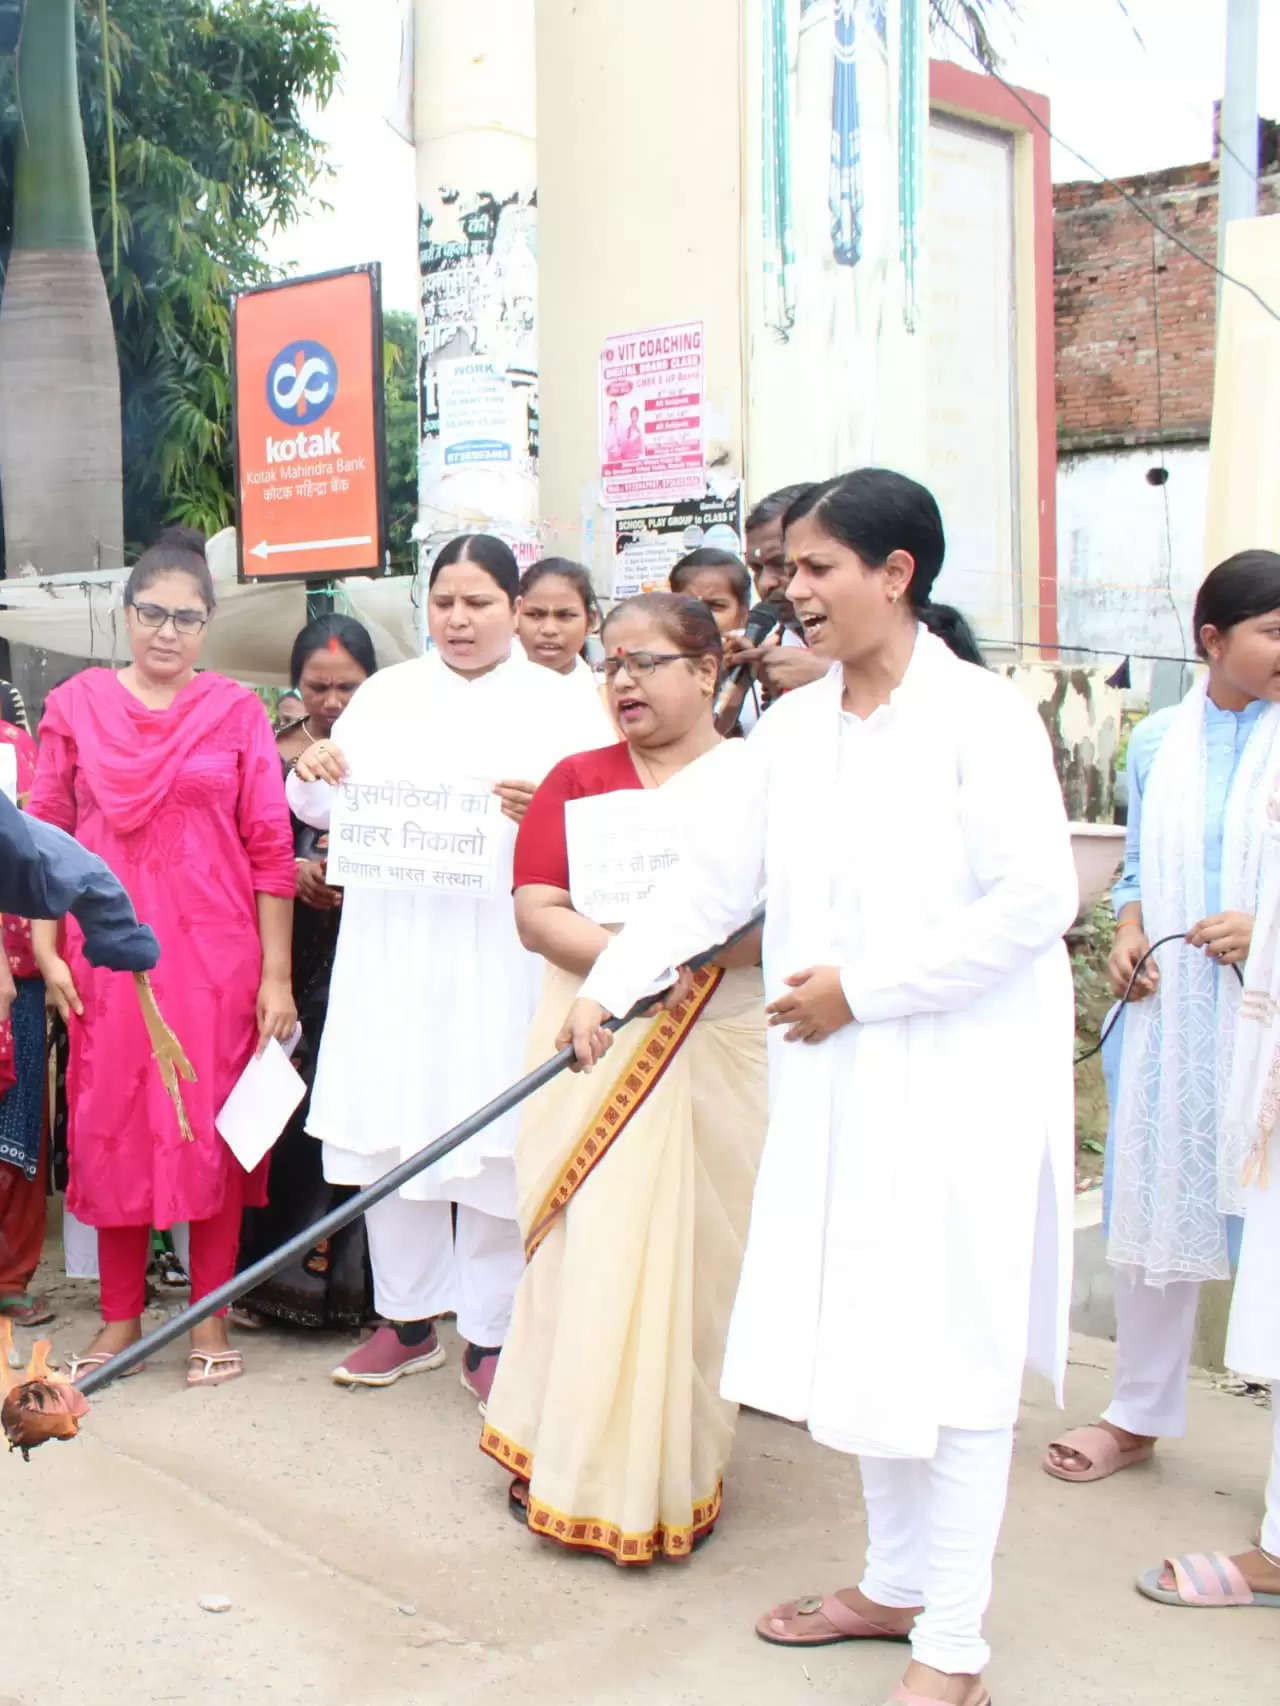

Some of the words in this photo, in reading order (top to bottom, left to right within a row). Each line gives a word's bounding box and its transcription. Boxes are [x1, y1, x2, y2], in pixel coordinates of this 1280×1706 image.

[618, 343, 636, 360] VIT
[640, 332, 700, 358] COACHING
[266, 427, 341, 464] kotak
[246, 468, 277, 484] Kotak
[280, 461, 333, 481] Mahindra
[336, 456, 366, 473] Bank
[263, 482, 292, 501] कोटक
[331, 477, 350, 494] बैंक
[618, 520, 646, 530] SCHOOL
[648, 518, 666, 528] PLAY
[668, 515, 693, 526] GROUP
[695, 514, 702, 524] to
[704, 512, 728, 523] CLASS
[339, 823, 393, 848] बाहर
[403, 820, 487, 857] निकालो
[337, 855, 381, 878] विशाल
[387, 866, 426, 884] भारत
[432, 866, 483, 889] संस्थान
